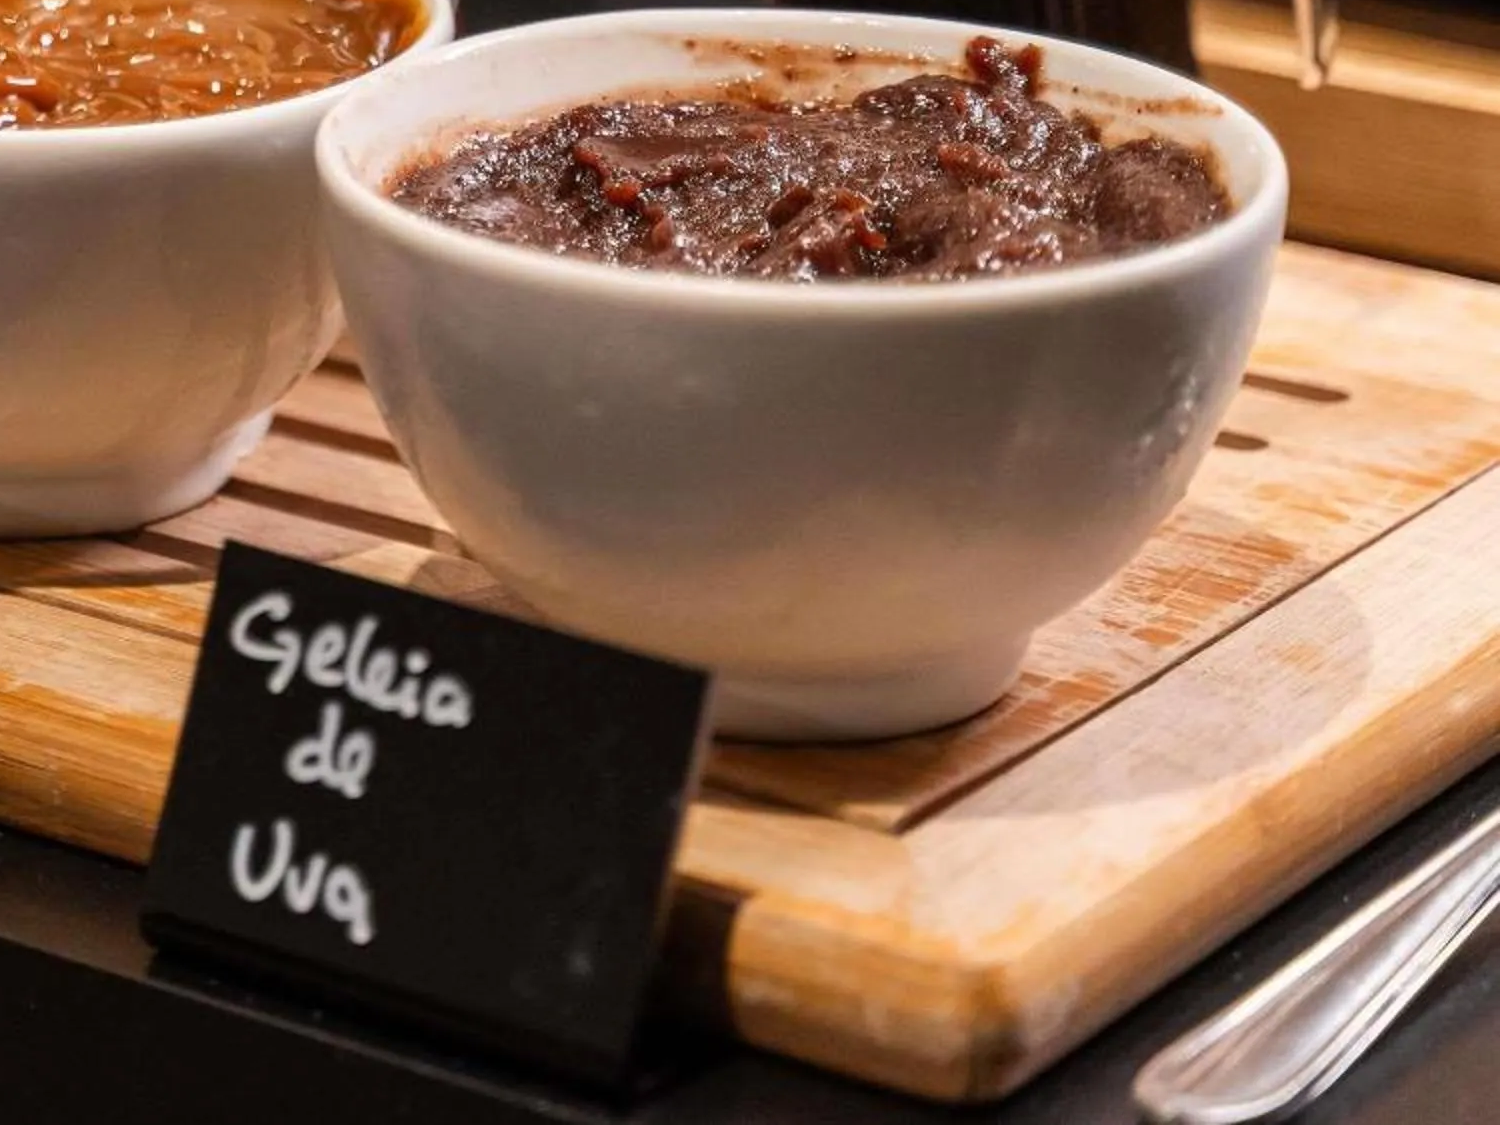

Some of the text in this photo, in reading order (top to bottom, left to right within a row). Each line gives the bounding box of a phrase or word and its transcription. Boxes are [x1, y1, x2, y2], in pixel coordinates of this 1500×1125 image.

[229, 591, 472, 730] Geleia
[284, 701, 375, 800] de
[229, 818, 375, 946] Uva
